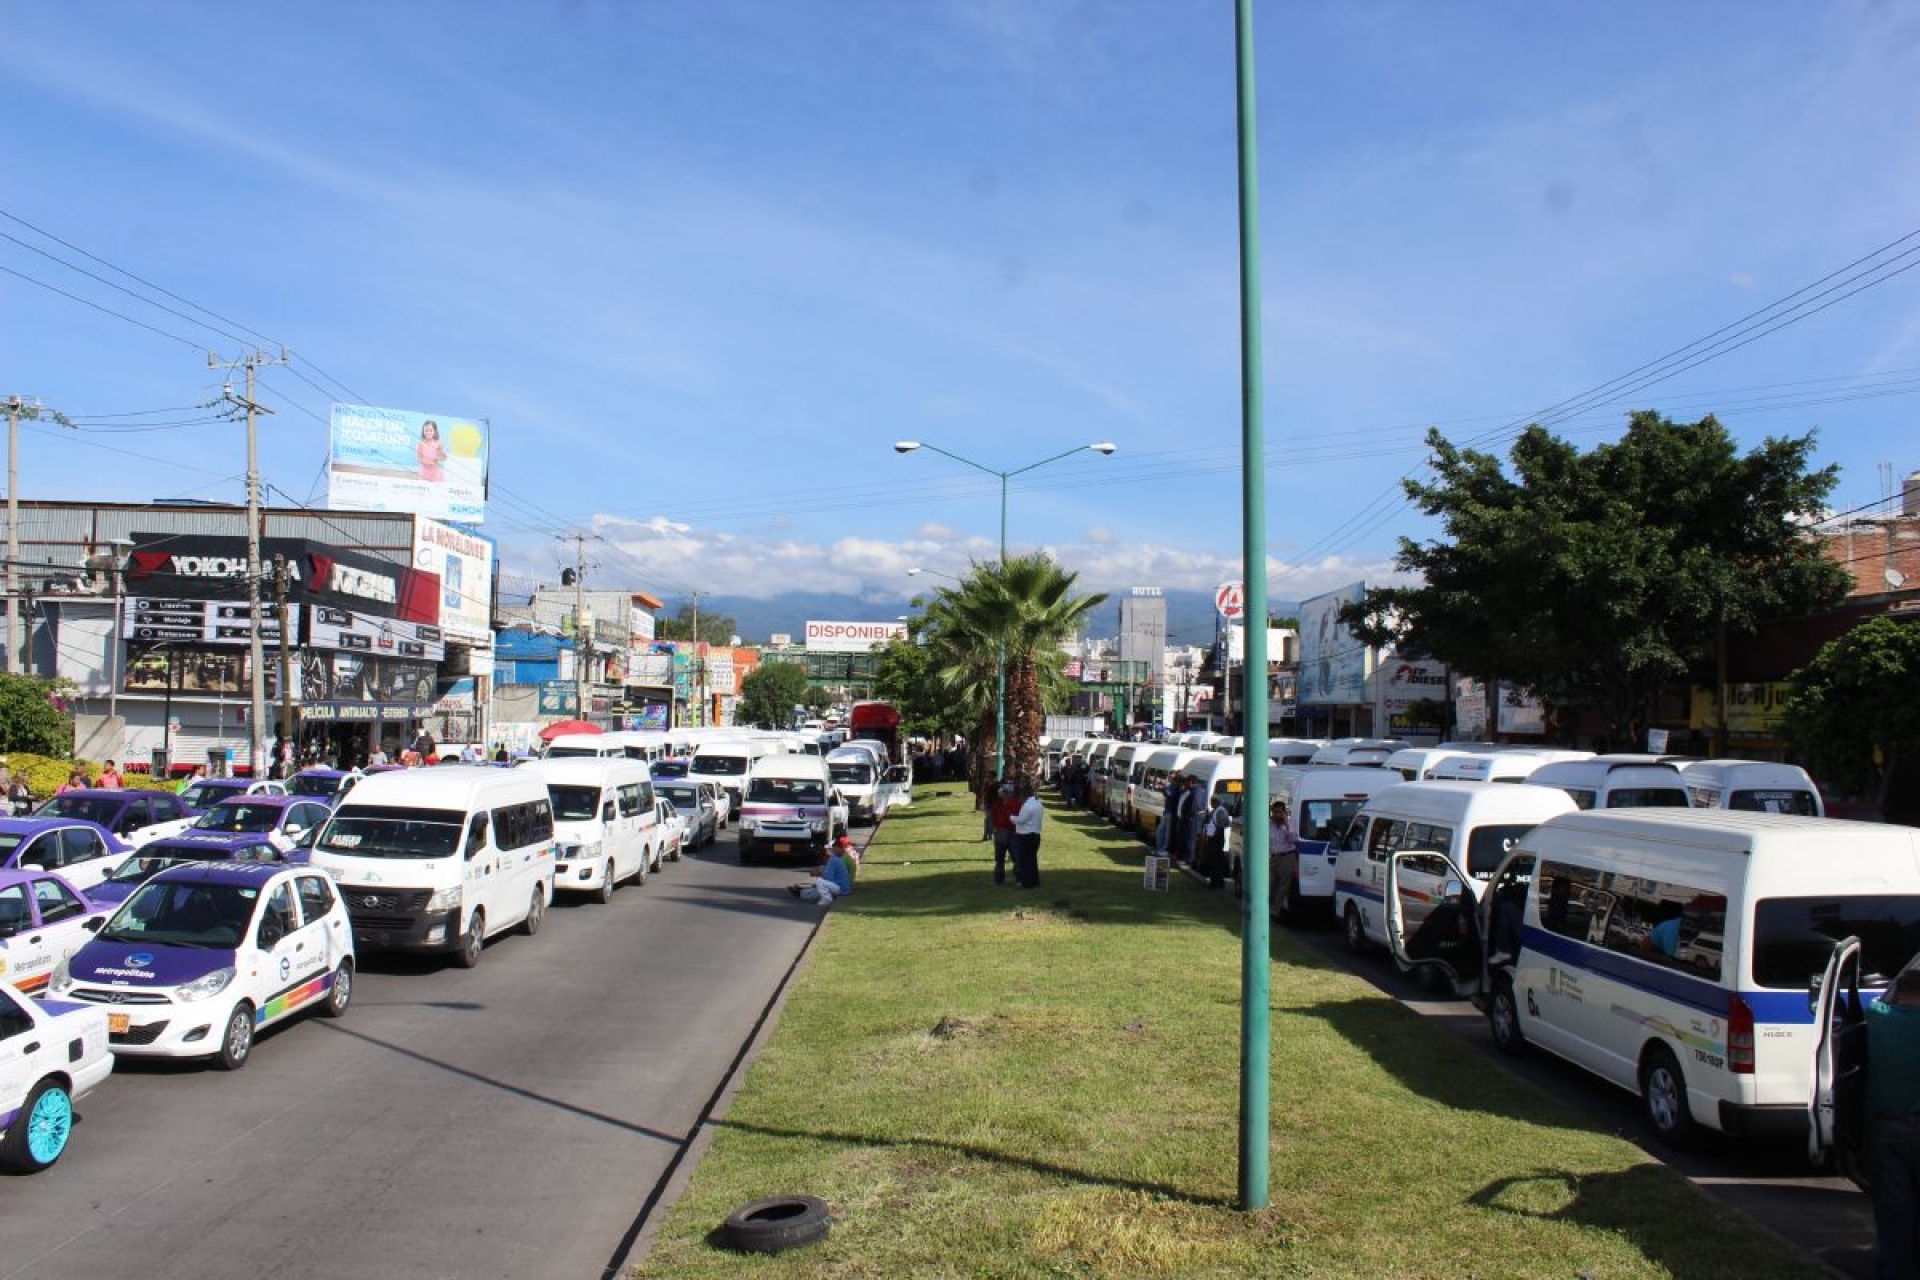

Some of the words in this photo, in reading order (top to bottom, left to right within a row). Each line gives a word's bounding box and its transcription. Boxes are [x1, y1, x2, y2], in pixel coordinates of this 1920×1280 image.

[171, 555, 301, 581] YOKOHA
[808, 625, 907, 639] DISPONIBLE
[94, 967, 155, 978] Metropolitano
